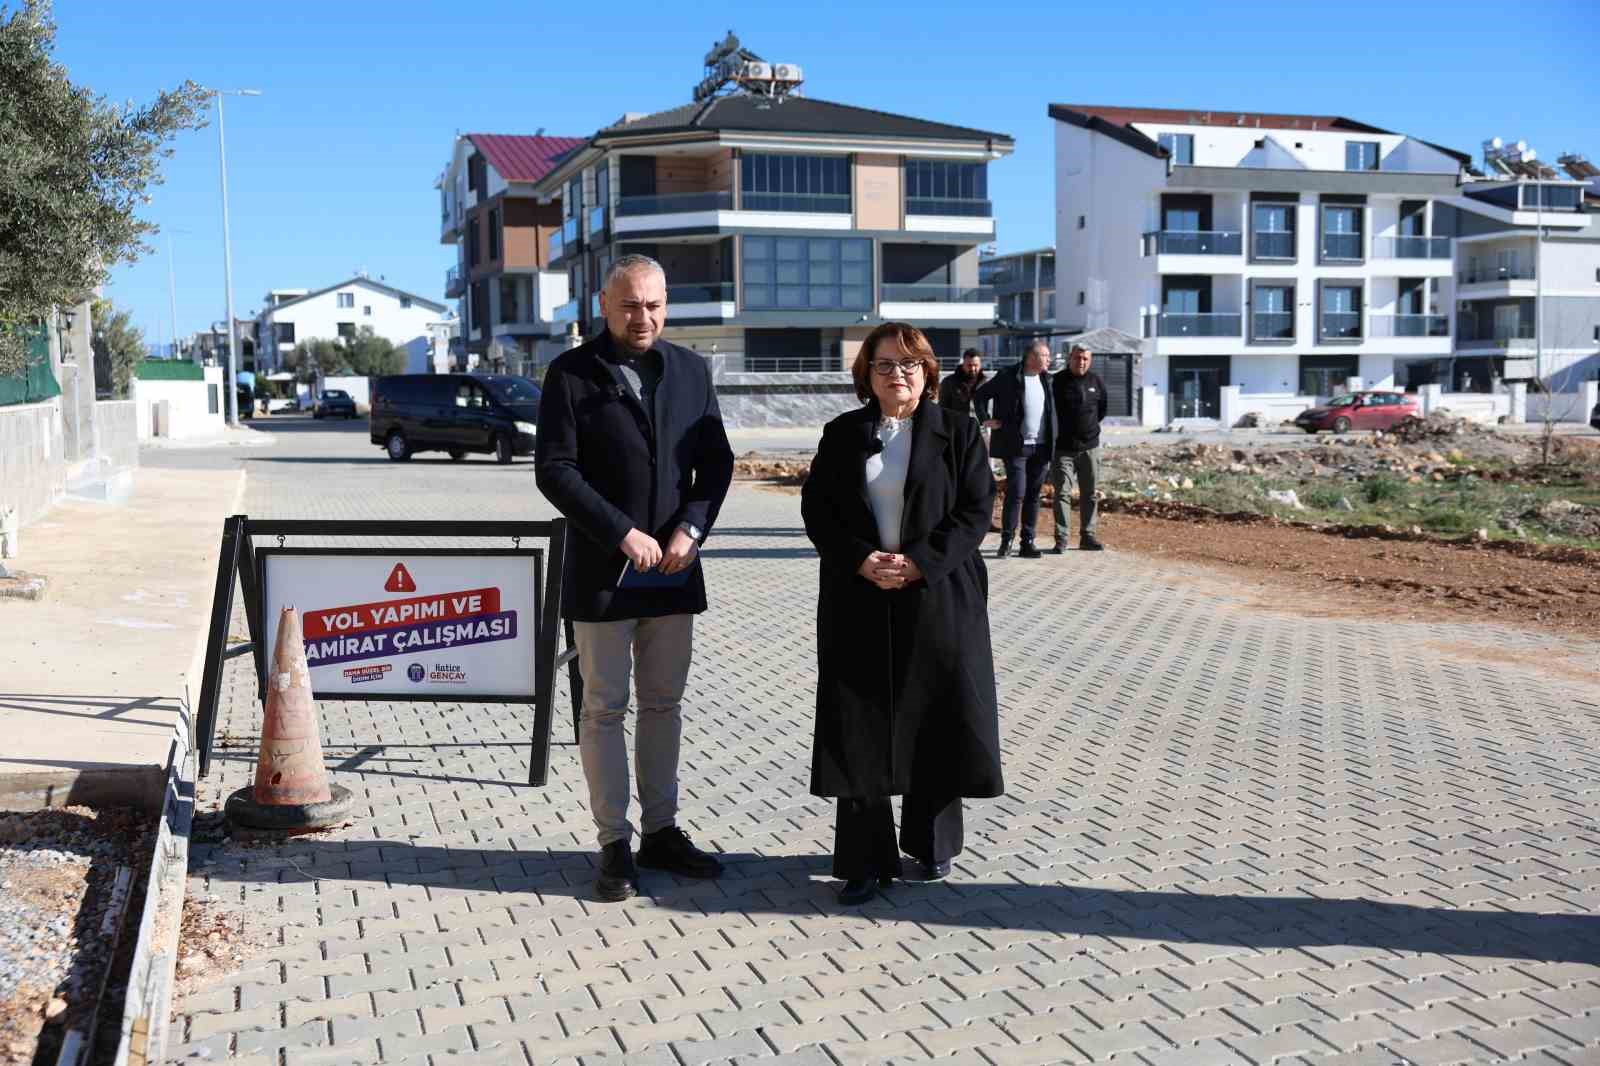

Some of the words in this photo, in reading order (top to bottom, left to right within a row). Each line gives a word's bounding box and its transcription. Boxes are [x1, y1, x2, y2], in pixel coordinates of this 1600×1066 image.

[321, 611, 365, 632] YOL
[371, 599, 445, 625] YAPIMI
[452, 594, 482, 613] VE
[303, 634, 388, 660] AMİRAT
[392, 617, 510, 653] ÇALIŞMASI
